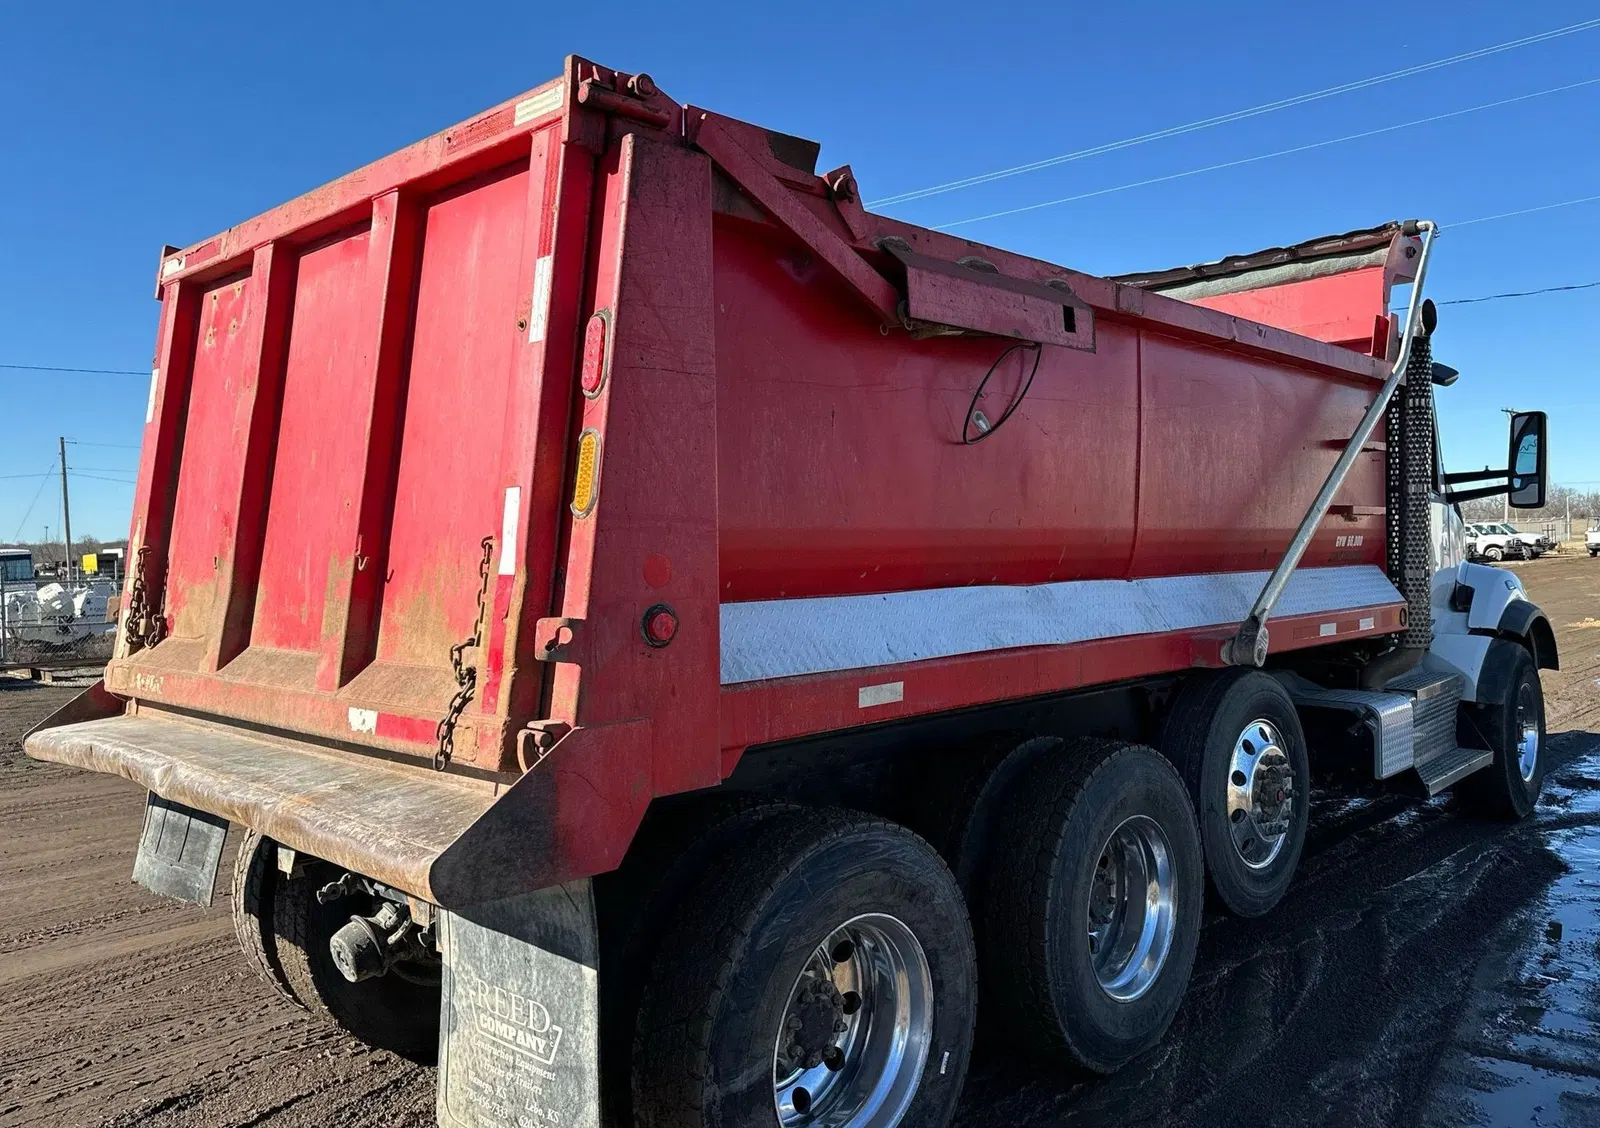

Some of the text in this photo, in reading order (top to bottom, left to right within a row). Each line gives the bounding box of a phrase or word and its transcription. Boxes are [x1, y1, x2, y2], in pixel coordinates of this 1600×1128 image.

[475, 978, 551, 1033] REED
[479, 1013, 547, 1054] COMPANY
[515, 1053, 556, 1081] Equipment
[495, 1085, 508, 1100] KS
[515, 1071, 543, 1096] Trailers
[524, 1098, 560, 1124] Lebo, KS
